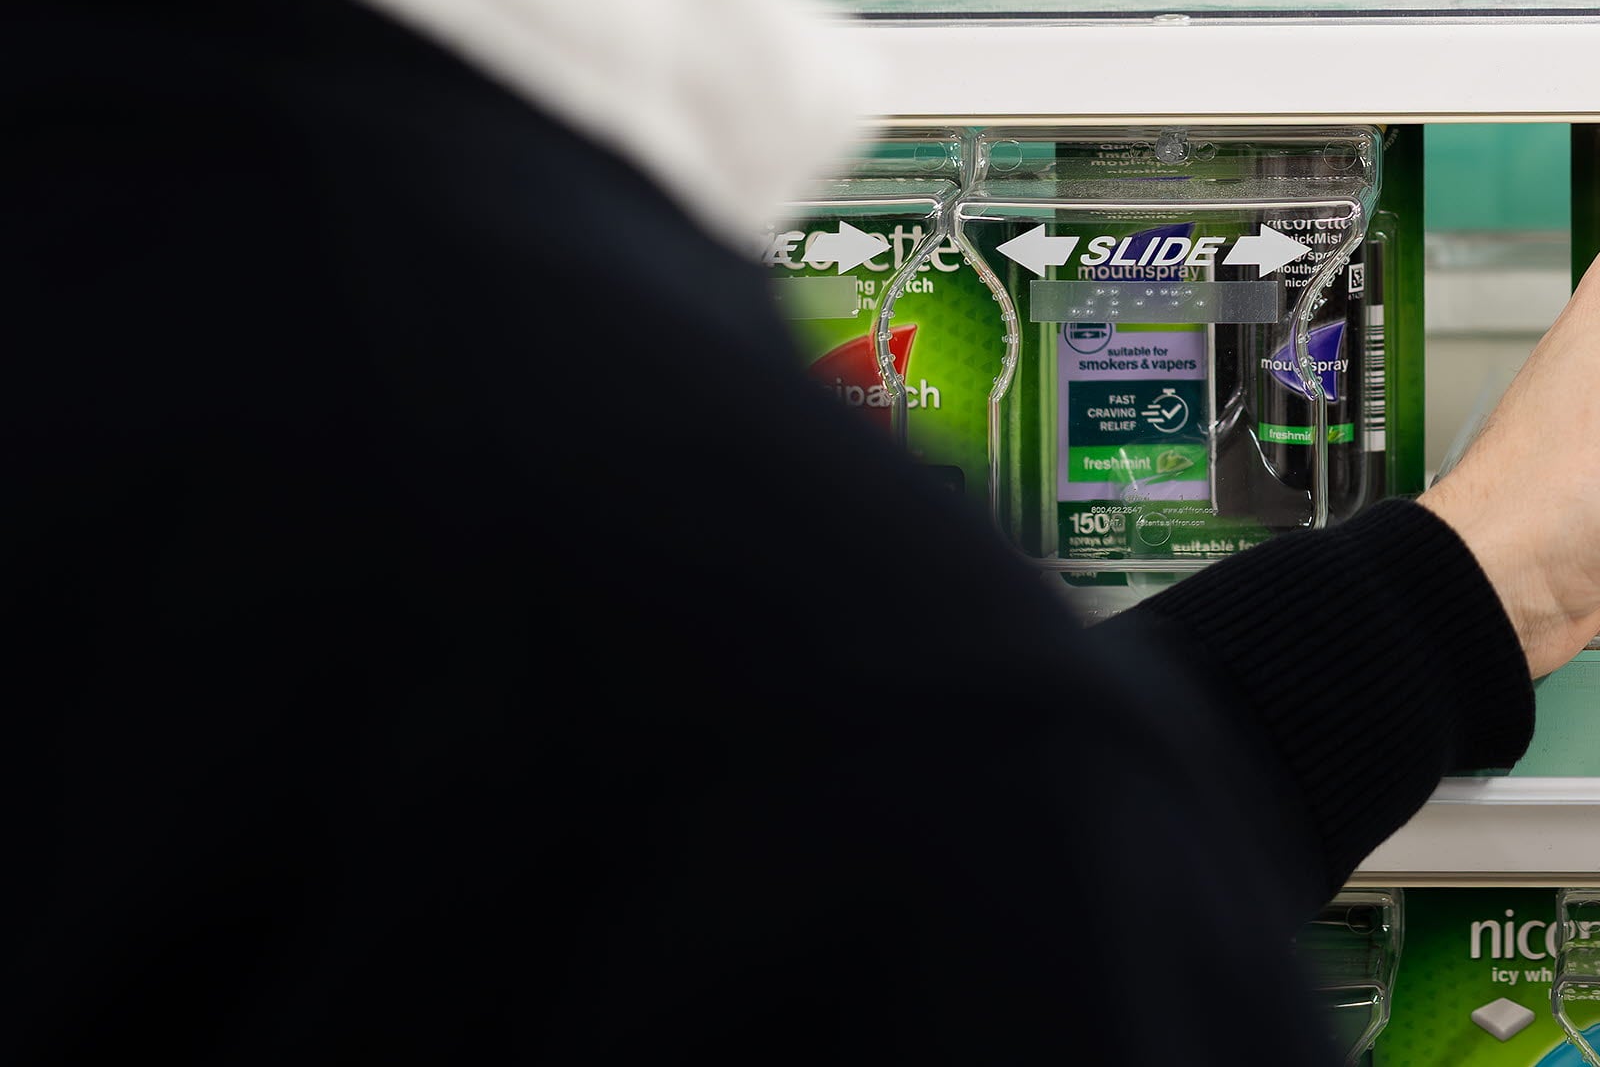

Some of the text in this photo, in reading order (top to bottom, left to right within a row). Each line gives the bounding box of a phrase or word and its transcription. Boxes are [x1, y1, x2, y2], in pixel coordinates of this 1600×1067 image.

[1080, 236, 1227, 266] SLIDE
[1107, 347, 1168, 356] suitable for
[1079, 359, 1197, 372] smokers & vapers
[1109, 395, 1136, 405] FAST
[1087, 408, 1136, 418] CRAVING
[1100, 421, 1137, 431] RELIEF
[1083, 457, 1151, 470] freshmint
[1492, 967, 1519, 985] icy
